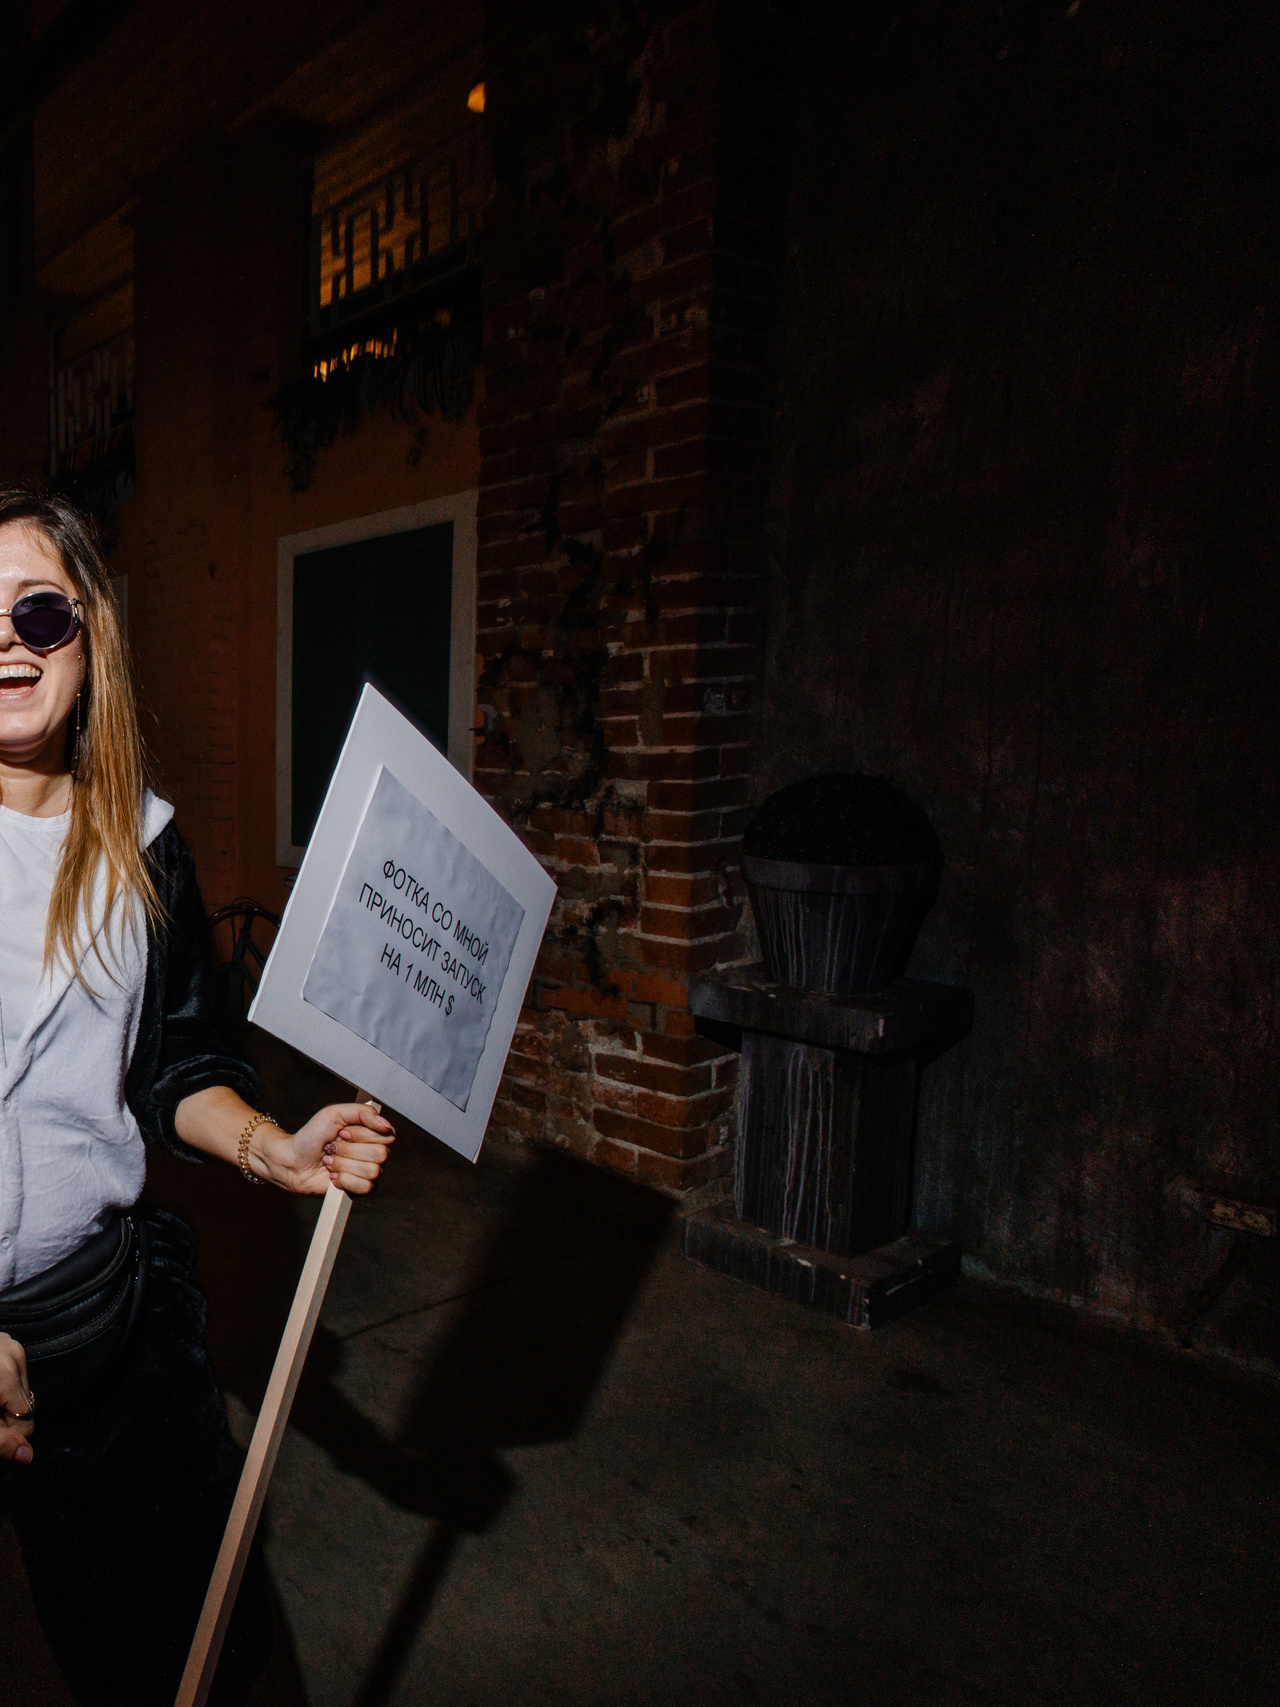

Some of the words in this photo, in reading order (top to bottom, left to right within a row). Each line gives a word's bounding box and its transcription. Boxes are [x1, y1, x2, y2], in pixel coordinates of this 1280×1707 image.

[358, 882, 441, 962] ПРИНОСИТ
[440, 951, 487, 1005] ЗАПУСК
[383, 860, 430, 914] ФОТКА
[431, 902, 453, 931] СО
[453, 920, 489, 966] МНОЙ
[380, 943, 402, 976] НА
[405, 963, 414, 983] 1
[413, 970, 446, 1009] МЛН
[445, 994, 455, 1017] $
